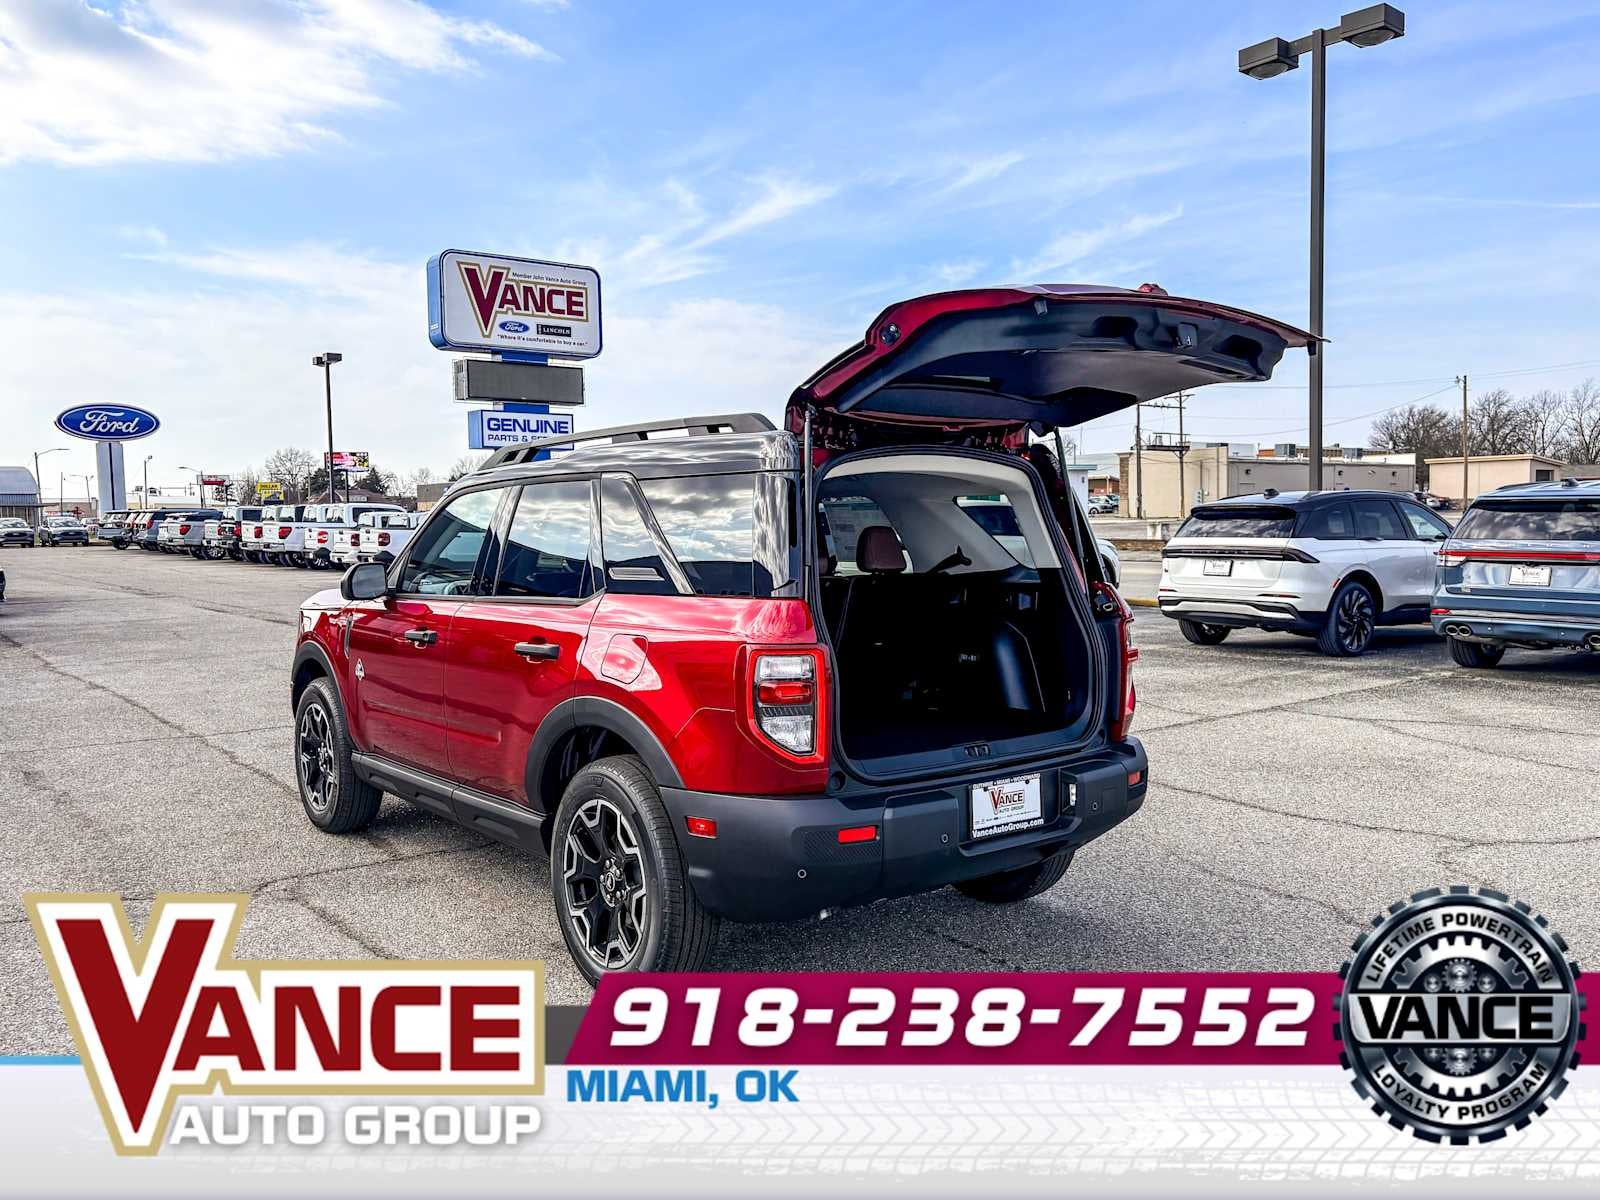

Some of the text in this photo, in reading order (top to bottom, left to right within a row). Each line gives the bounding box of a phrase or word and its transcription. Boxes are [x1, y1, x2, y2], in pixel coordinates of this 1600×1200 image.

[464, 267, 584, 334] VANCE
[504, 322, 524, 332] Ford
[542, 327, 571, 335] LINCOLN
[79, 410, 140, 434] Ford
[487, 417, 569, 434] GENUINE
[488, 434, 519, 442] PARTS
[990, 789, 1023, 810] VANCE
[972, 818, 1044, 838] VanceAutoGroup.com
